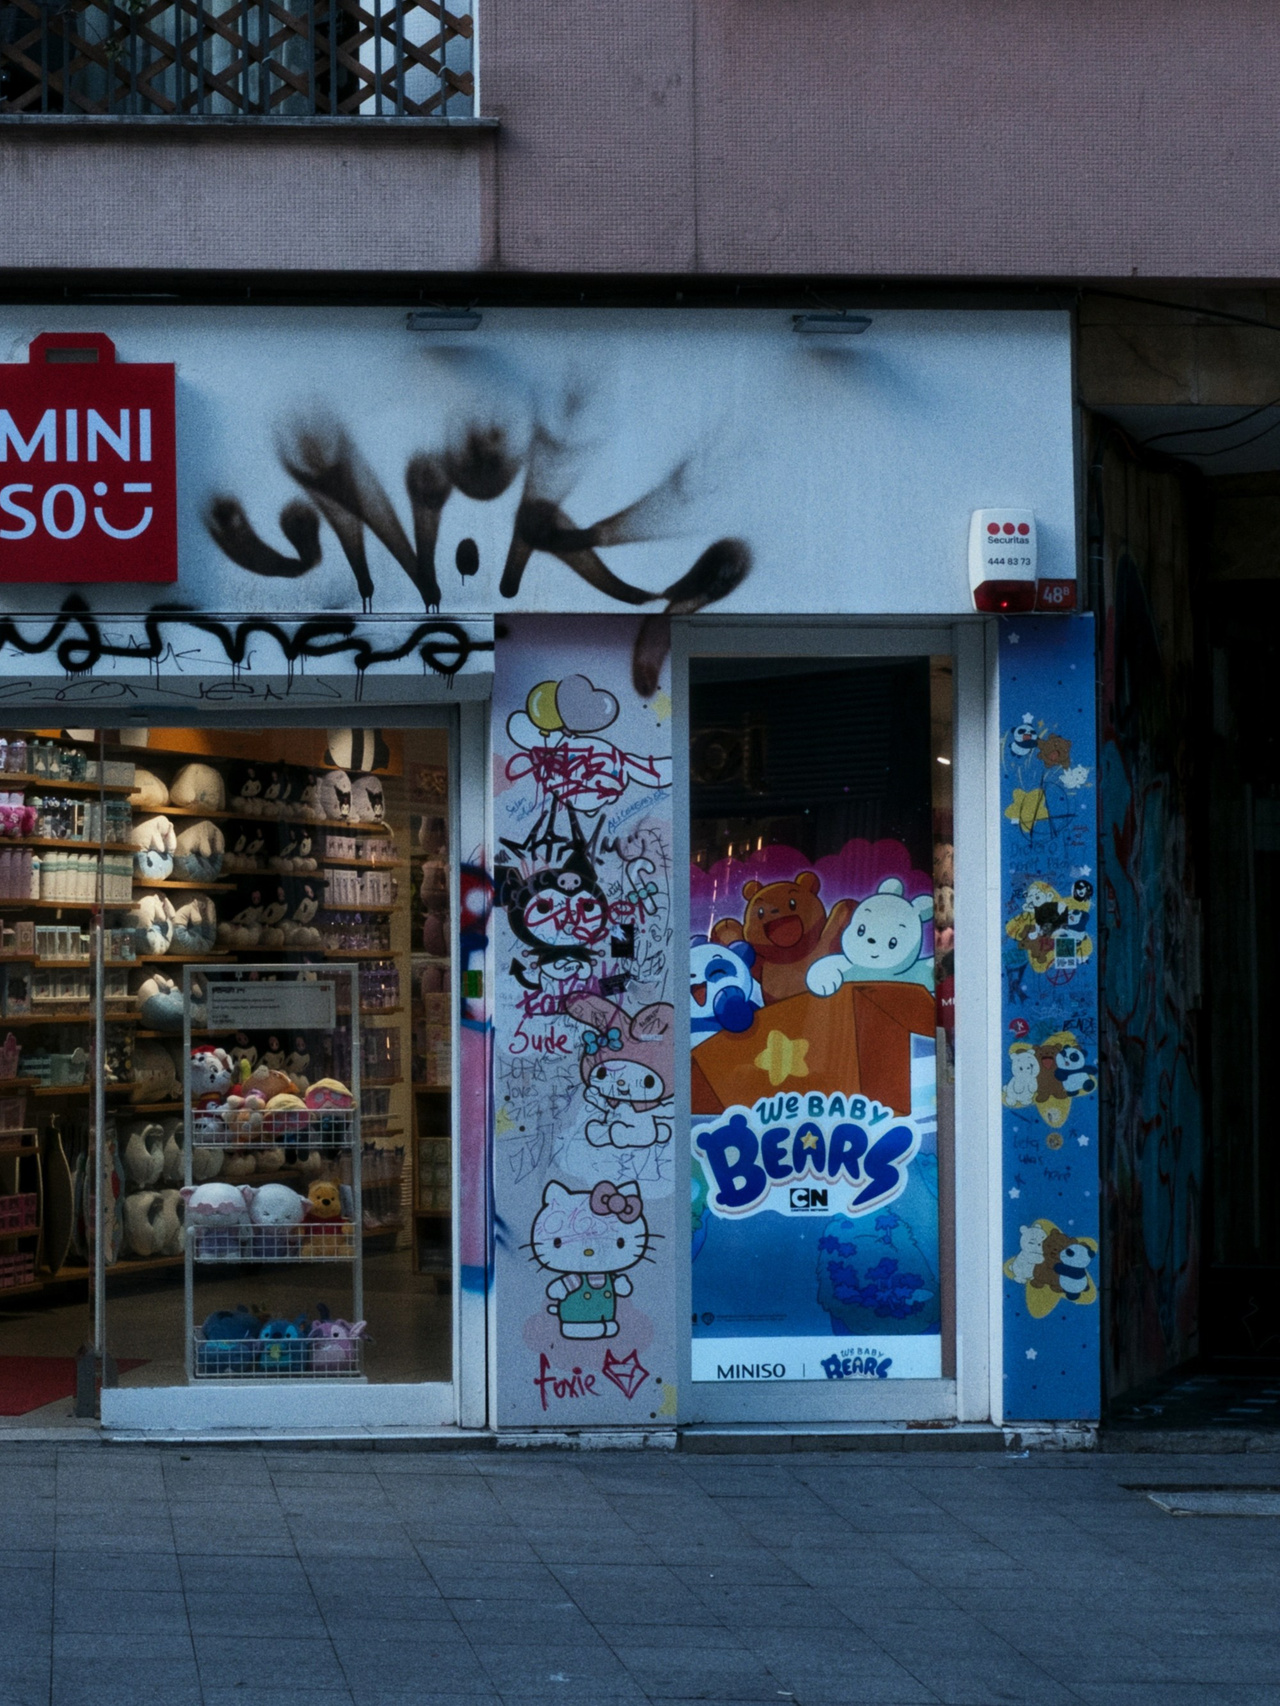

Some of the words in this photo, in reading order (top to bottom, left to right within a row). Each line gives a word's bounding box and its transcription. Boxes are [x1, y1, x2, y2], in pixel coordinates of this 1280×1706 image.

[987, 536, 1030, 545] Securitas
[987, 557, 1005, 566] 444
[1007, 557, 1019, 566] 83
[1020, 557, 1031, 566] 73
[509, 1021, 572, 1054] Sude
[756, 1096, 799, 1125] We
[808, 1095, 890, 1126] BABY
[696, 1114, 914, 1208] BEARS
[790, 1188, 828, 1208] CN
[857, 1347, 884, 1358] BABY
[717, 1363, 786, 1379] MINISO
